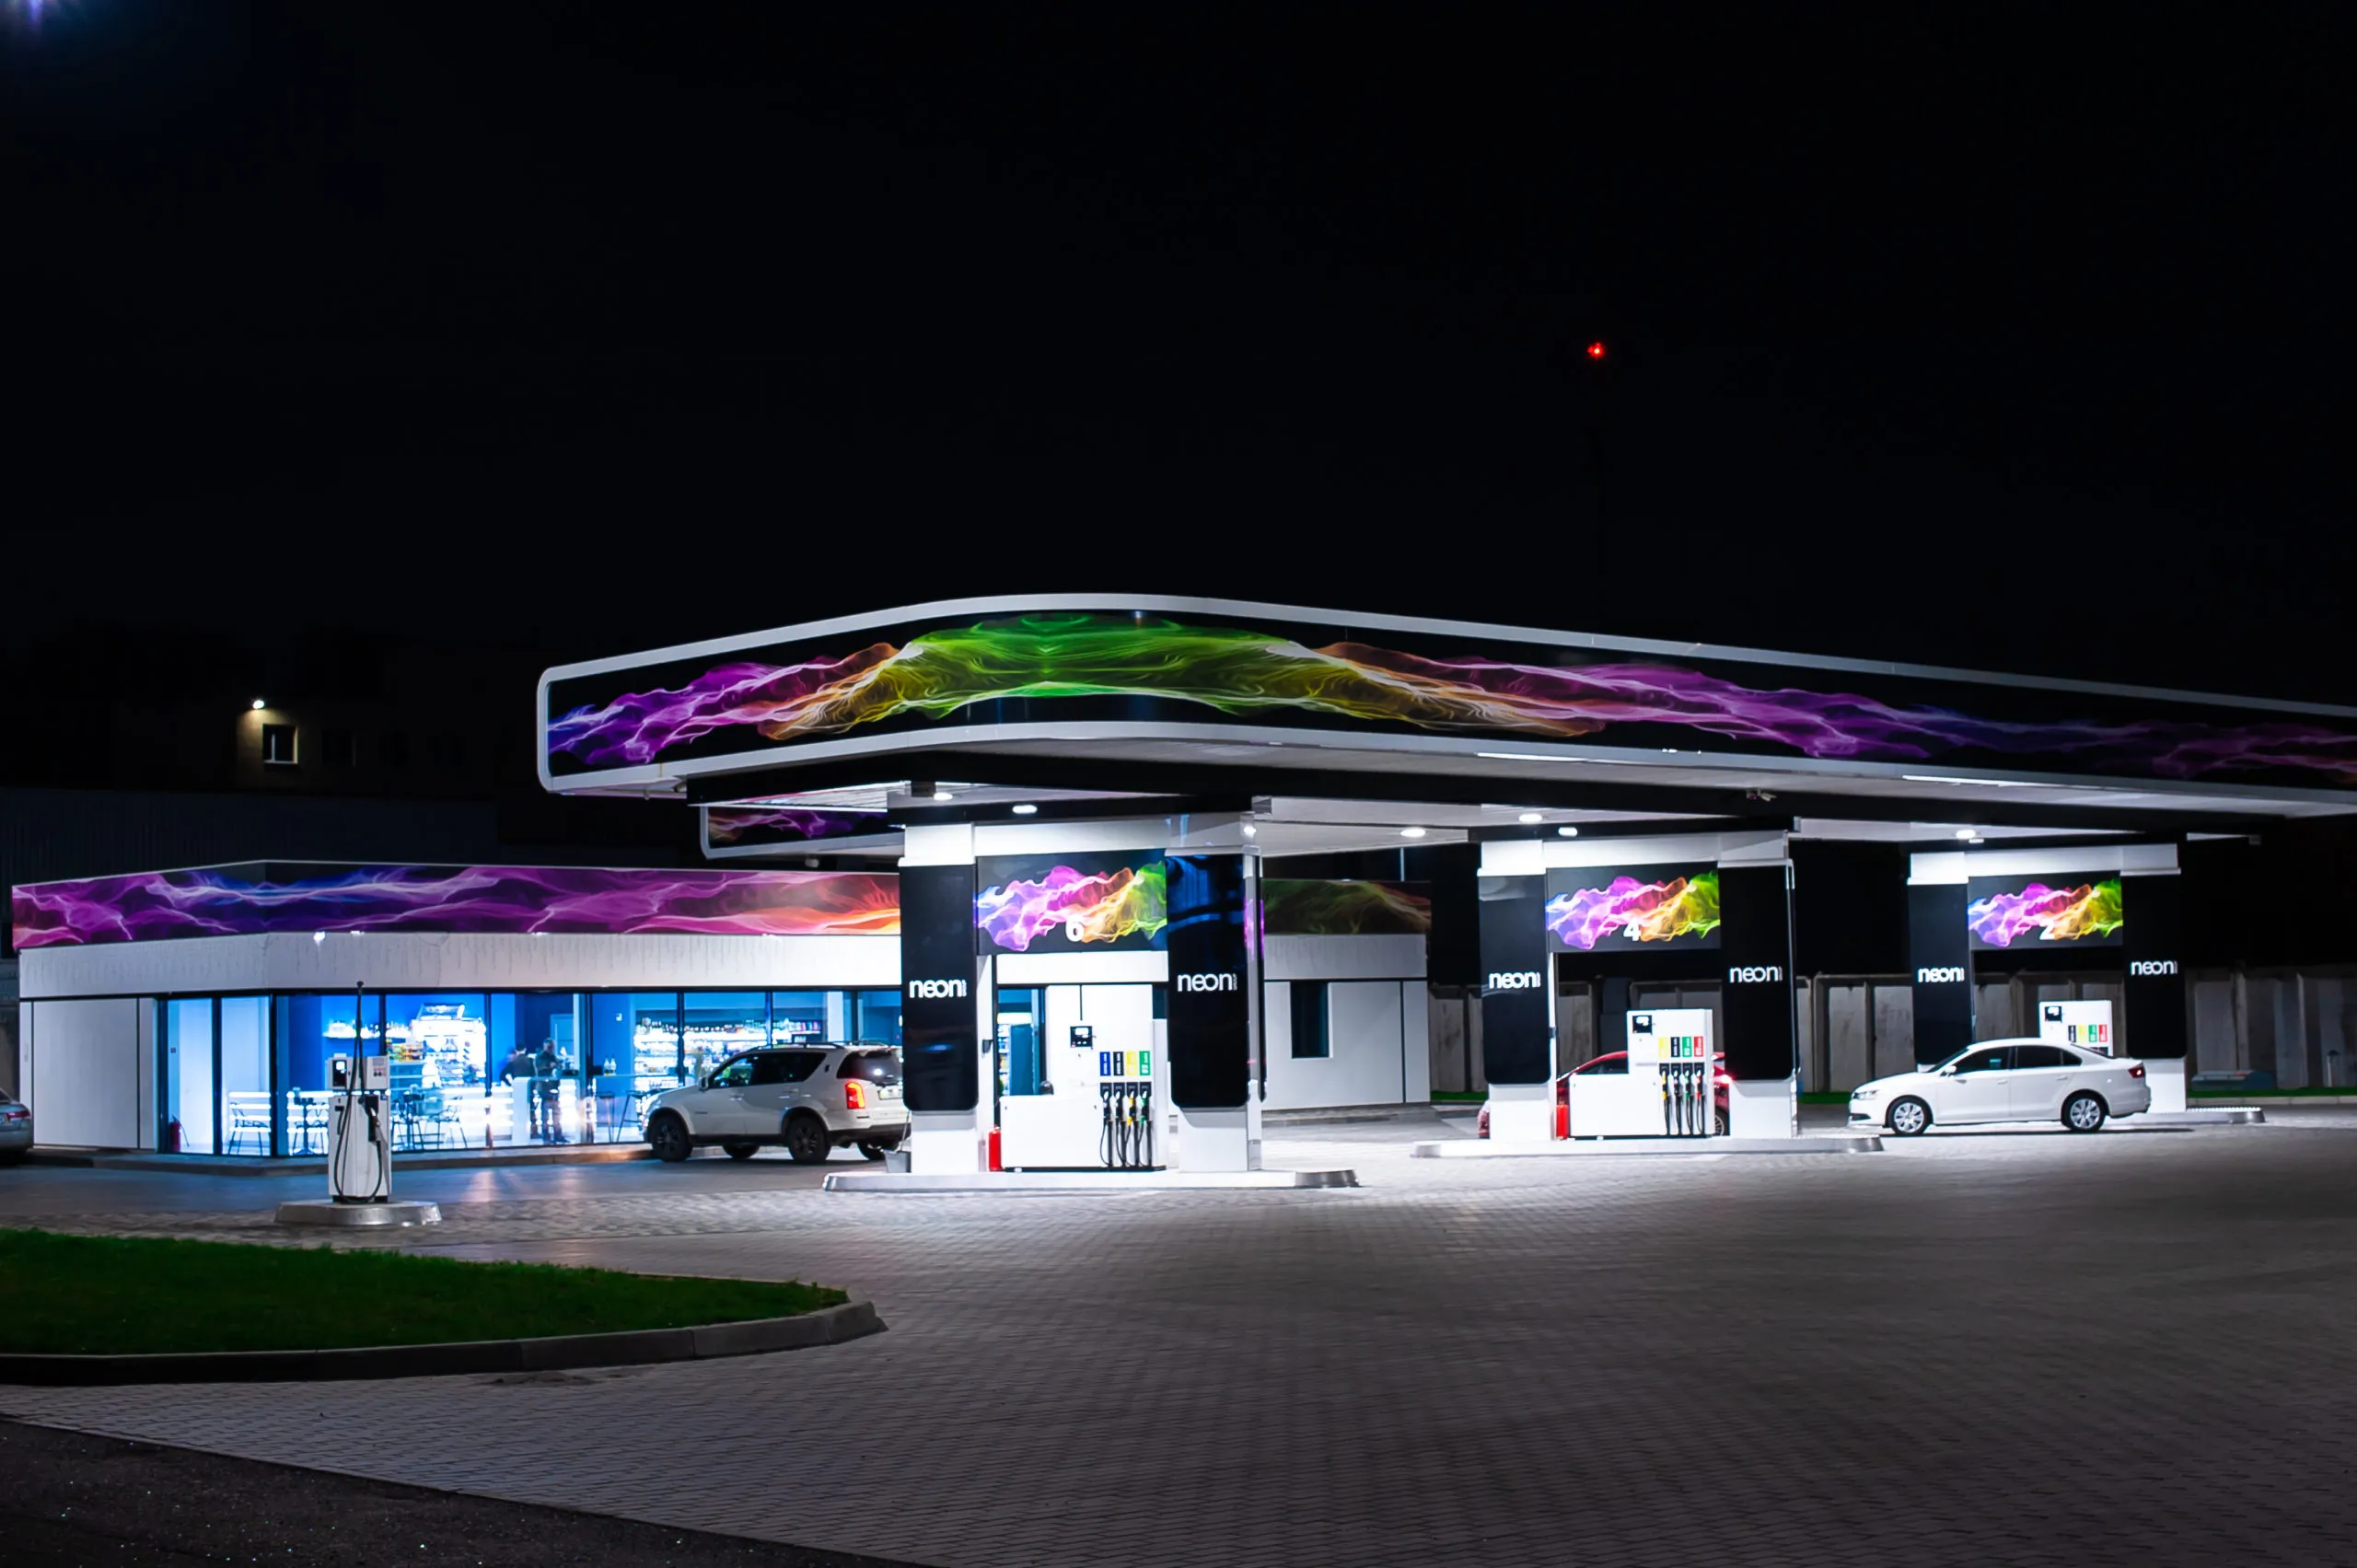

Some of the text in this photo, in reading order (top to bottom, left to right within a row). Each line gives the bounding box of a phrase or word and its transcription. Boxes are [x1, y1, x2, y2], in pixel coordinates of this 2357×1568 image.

[1065, 914, 1085, 942] 6
[1623, 917, 1642, 941] 4
[2039, 919, 2055, 940] 2
[1730, 967, 1779, 983] neon
[1918, 967, 1961, 982] neon
[2131, 960, 2174, 976] neon
[909, 980, 962, 998] neon
[1178, 973, 1233, 992] neon
[1489, 972, 1538, 989] neon
